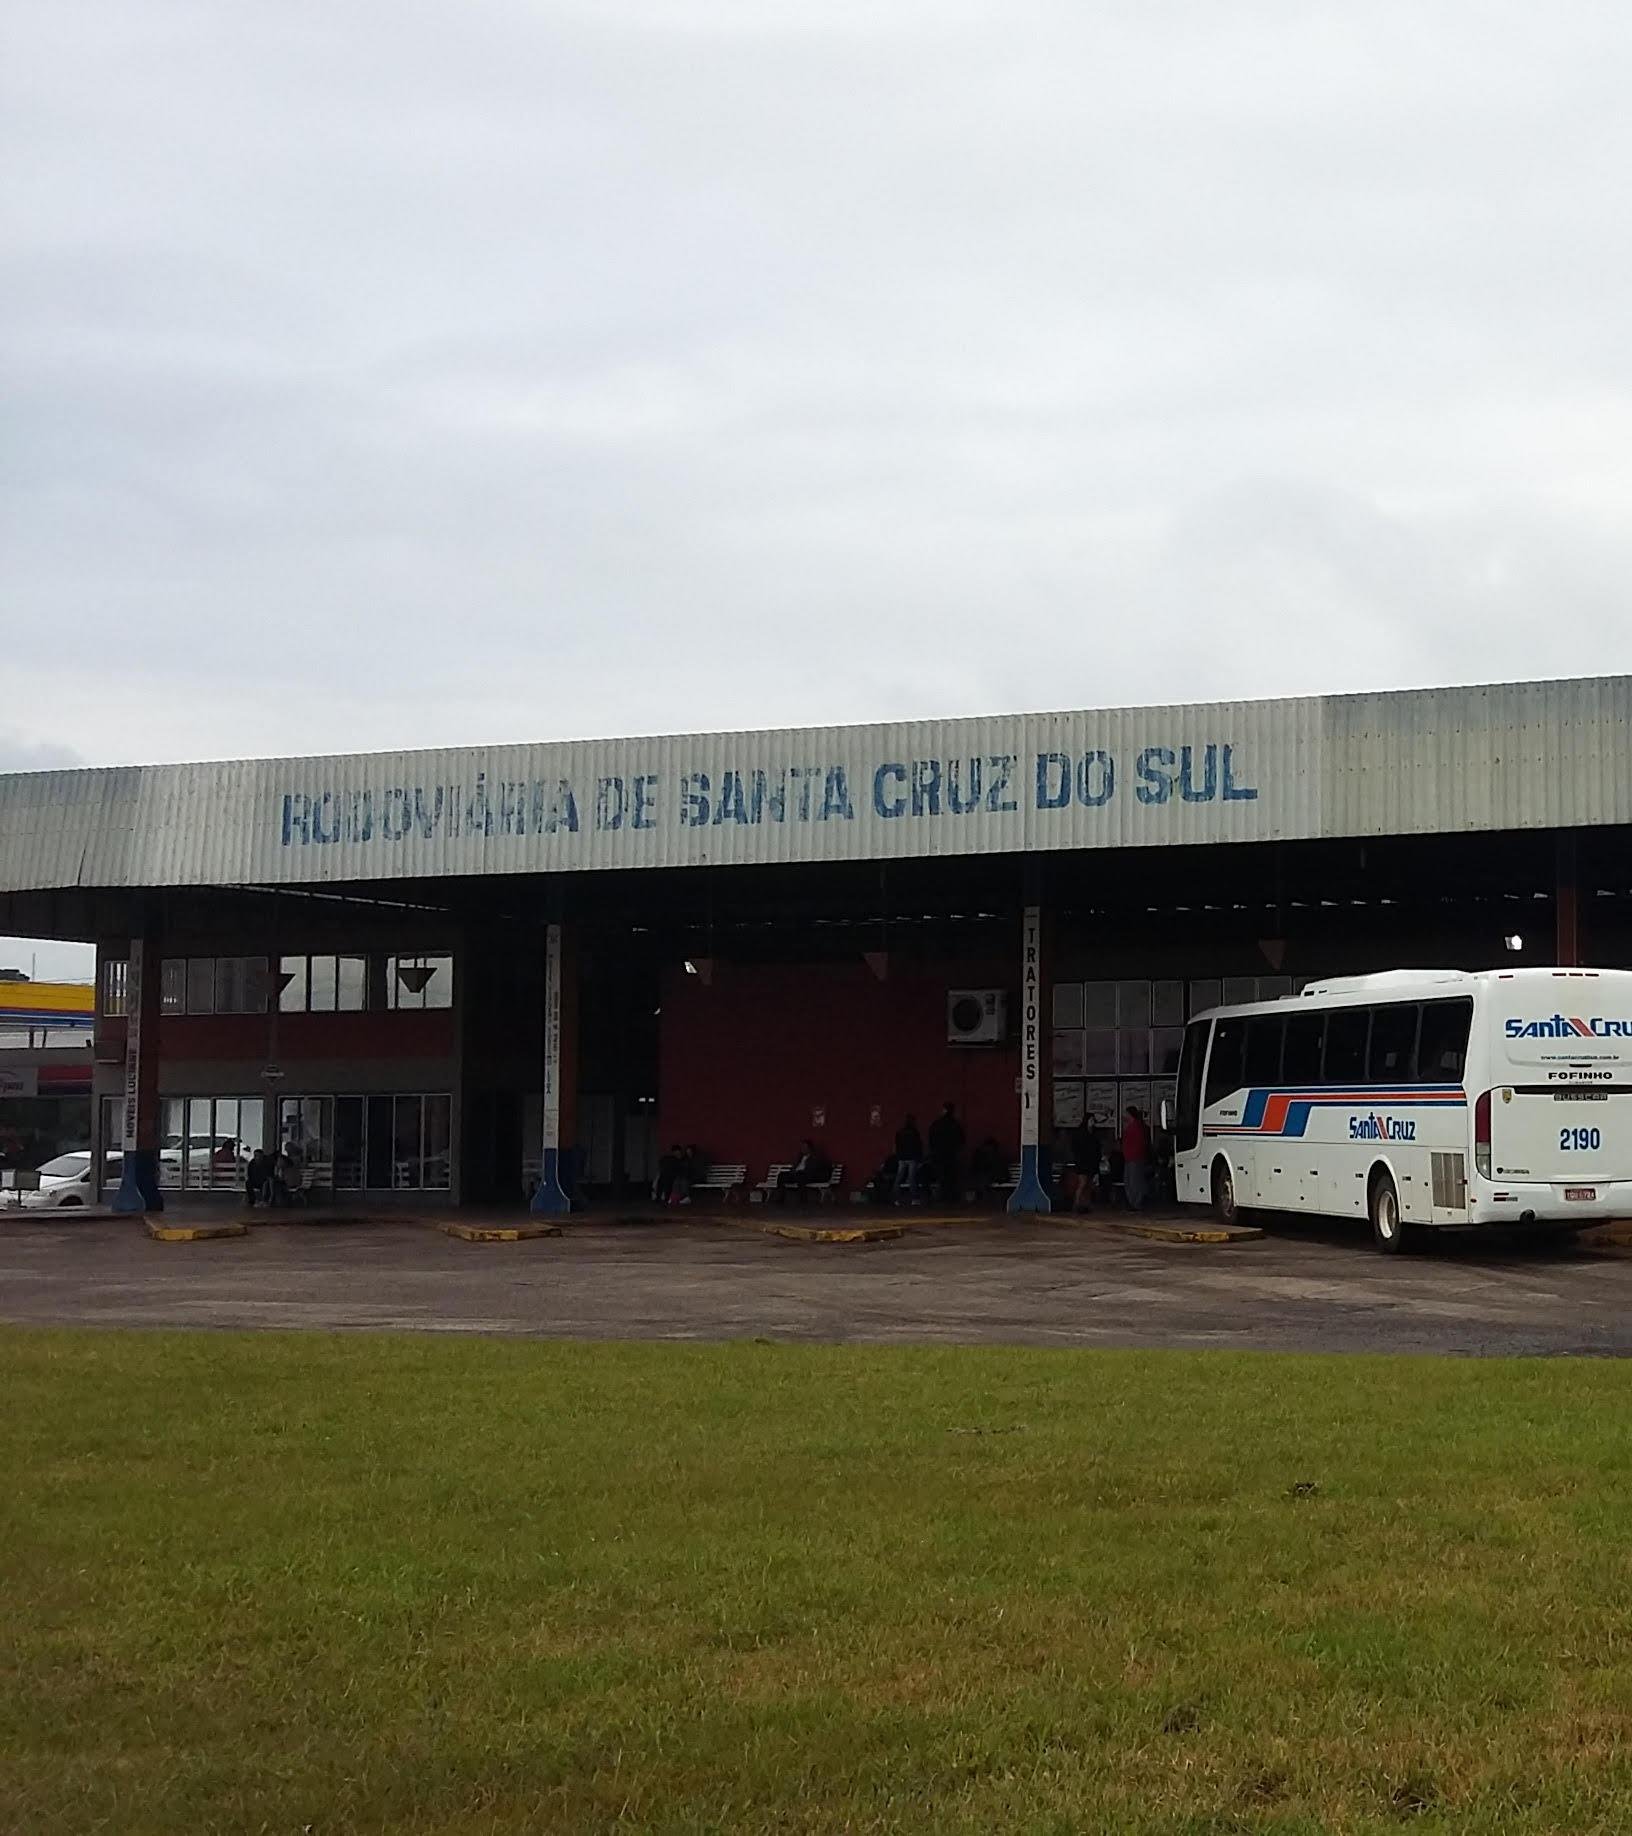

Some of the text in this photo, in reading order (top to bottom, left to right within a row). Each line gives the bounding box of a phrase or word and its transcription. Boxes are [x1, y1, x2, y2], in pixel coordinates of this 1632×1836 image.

[282, 744, 1258, 845] RODOVIÁRIA DE SANTA CRUZ DO SUL
[1025, 928, 1036, 1080] TRATORES
[1548, 1072, 1612, 1080] FOFINHO
[1560, 1128, 1600, 1150] 2190
